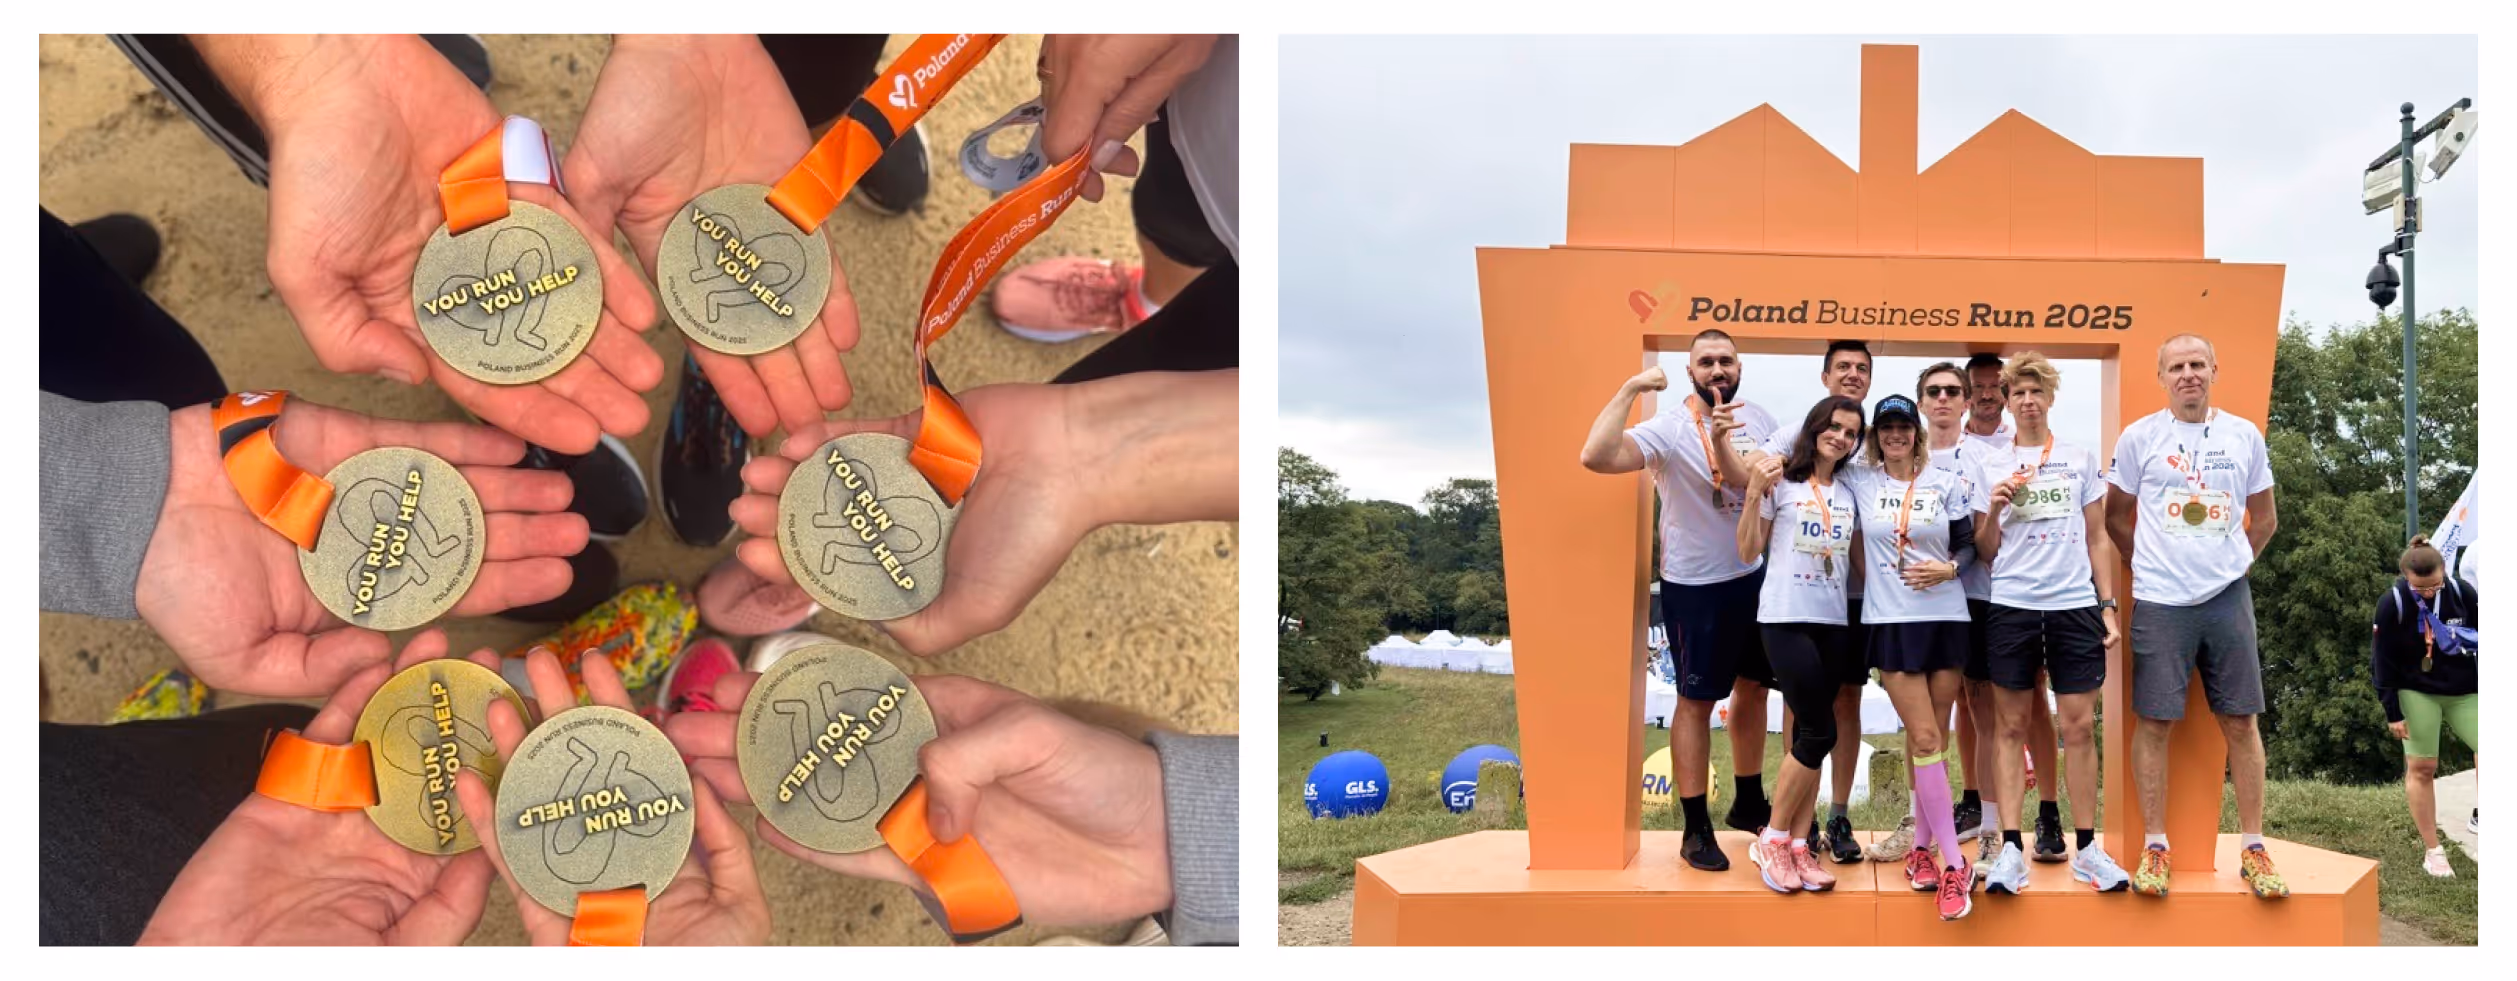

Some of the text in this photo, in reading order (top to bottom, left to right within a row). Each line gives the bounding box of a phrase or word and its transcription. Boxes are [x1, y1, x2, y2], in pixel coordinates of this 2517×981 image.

[691, 208, 762, 271] YOU RUN
[928, 272, 974, 334] Poland
[973, 213, 1036, 279] Business
[1040, 187, 1073, 220] Run
[423, 269, 516, 316] YOU RUN
[480, 265, 578, 315] YOU HELP
[716, 252, 793, 317] YOU HELP
[1687, 297, 2133, 330] Poland Business Run 2025
[828, 449, 893, 532] YOU RUN
[1880, 498, 1924, 511] 105
[2168, 503, 2220, 520] 06
[386, 470, 423, 570] YOU HELP
[843, 502, 914, 590] YOU HELP
[1801, 521, 1841, 540] 105
[353, 523, 390, 615] YOU RUN
[431, 682, 454, 736] HELP
[832, 685, 907, 768] YOU RUN
[778, 712, 856, 802] YOU HELP
[423, 747, 455, 847] YOU RUN
[518, 786, 628, 828] YOU HELP
[585, 794, 685, 834] YOU RUN
[1345, 780, 1379, 794] GLS.
